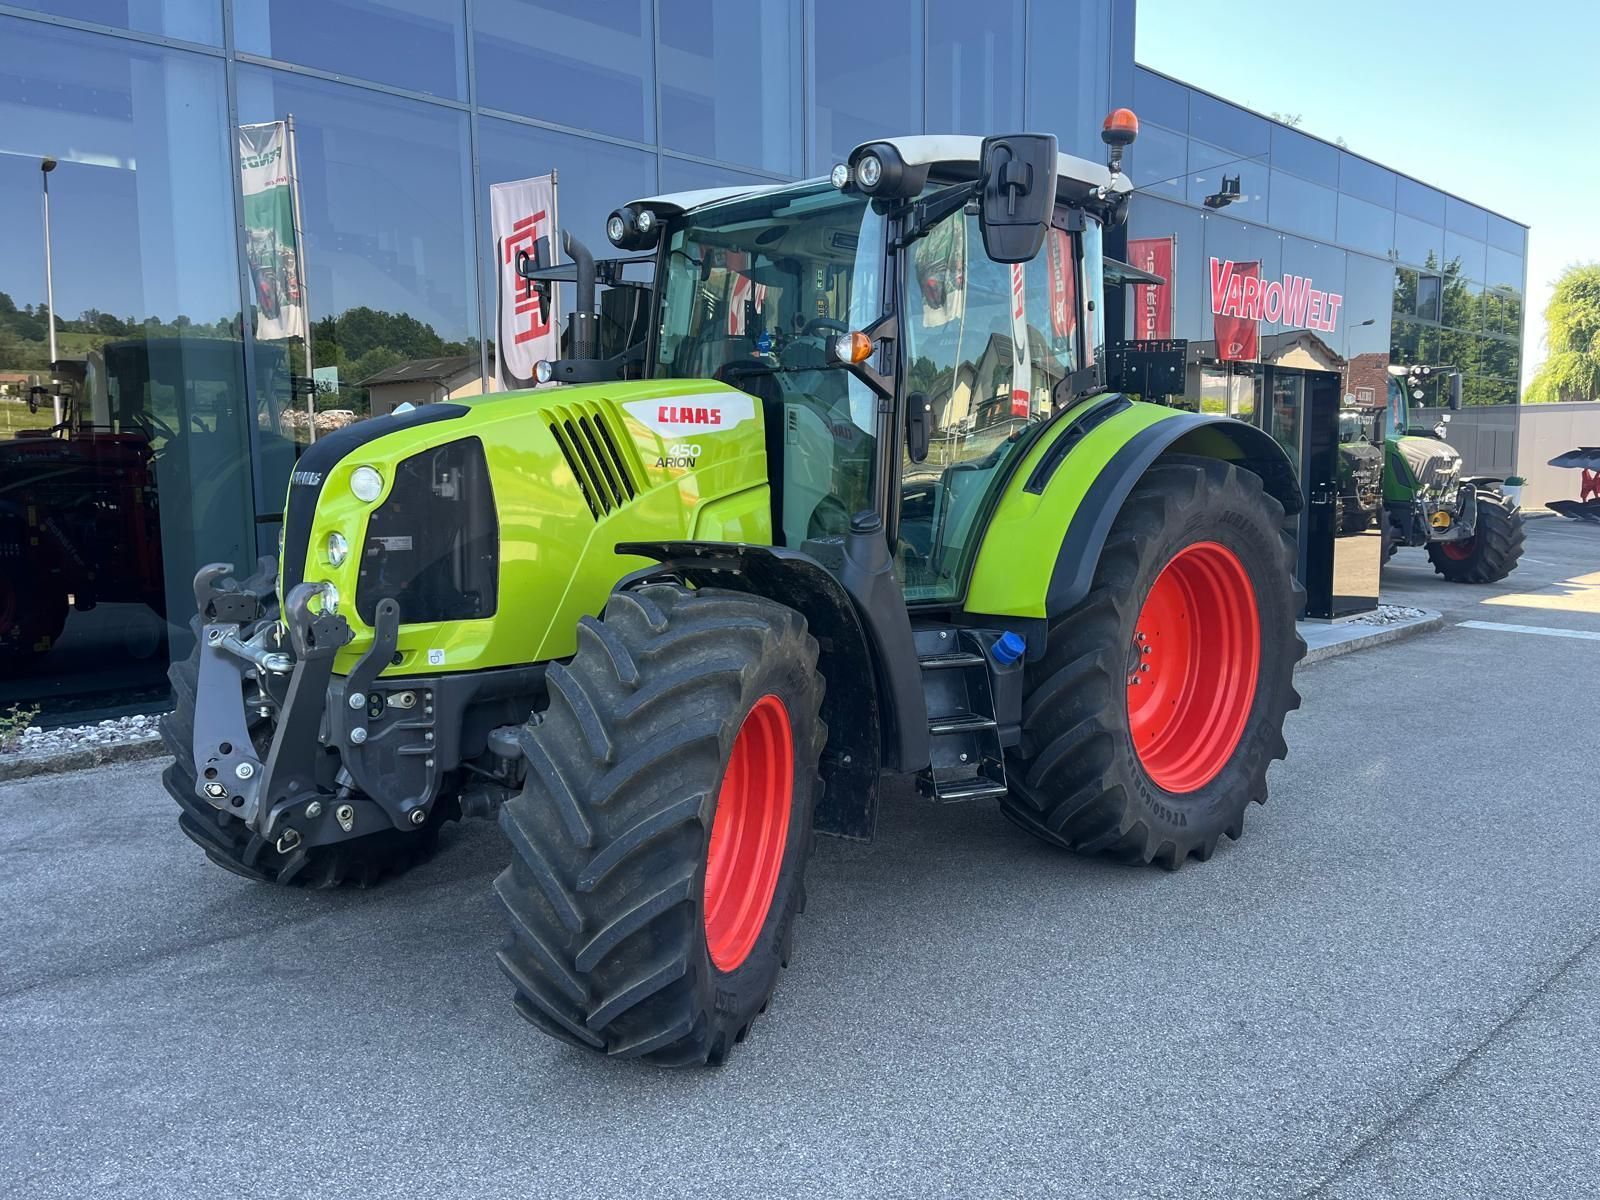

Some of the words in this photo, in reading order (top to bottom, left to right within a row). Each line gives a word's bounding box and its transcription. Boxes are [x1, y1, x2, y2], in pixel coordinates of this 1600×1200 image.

[658, 406, 722, 424] CLAAS
[668, 444, 702, 458] 450
[655, 457, 696, 467] ARION
